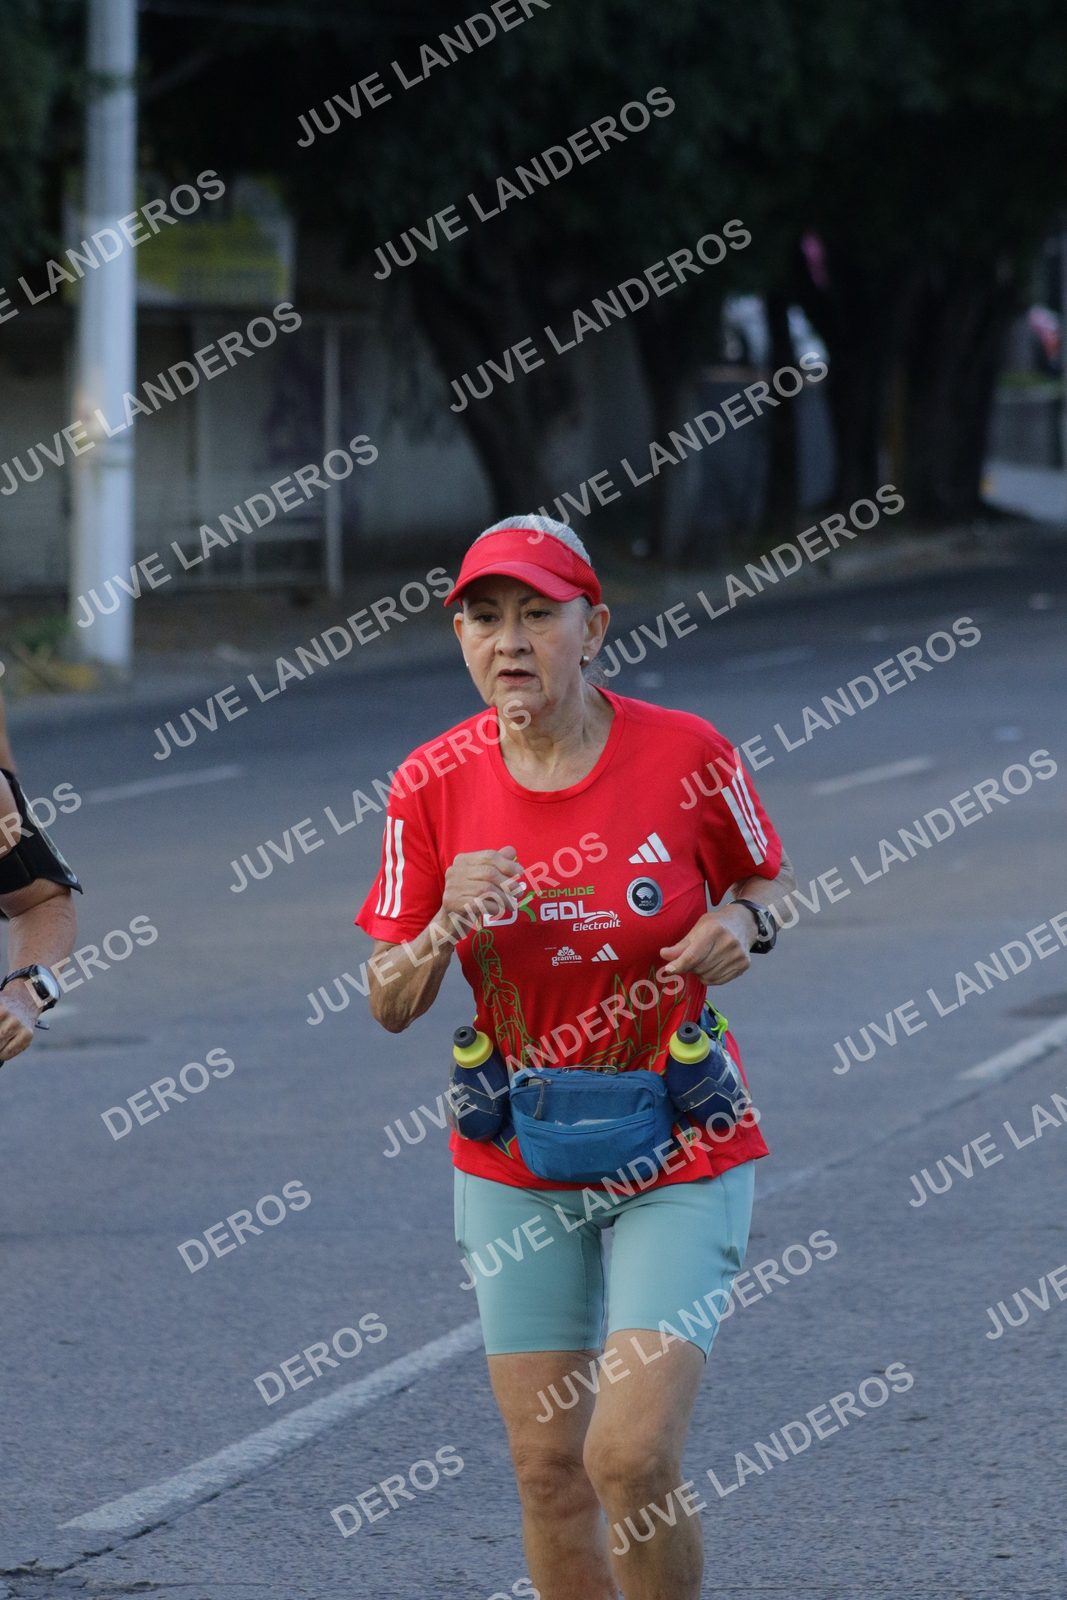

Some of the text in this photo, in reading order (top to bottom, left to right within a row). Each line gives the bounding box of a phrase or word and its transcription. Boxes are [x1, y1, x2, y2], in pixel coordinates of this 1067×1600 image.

[539, 886, 595, 898] COMUDE
[540, 900, 597, 921] GDL
[572, 919, 621, 932] Electrolit
